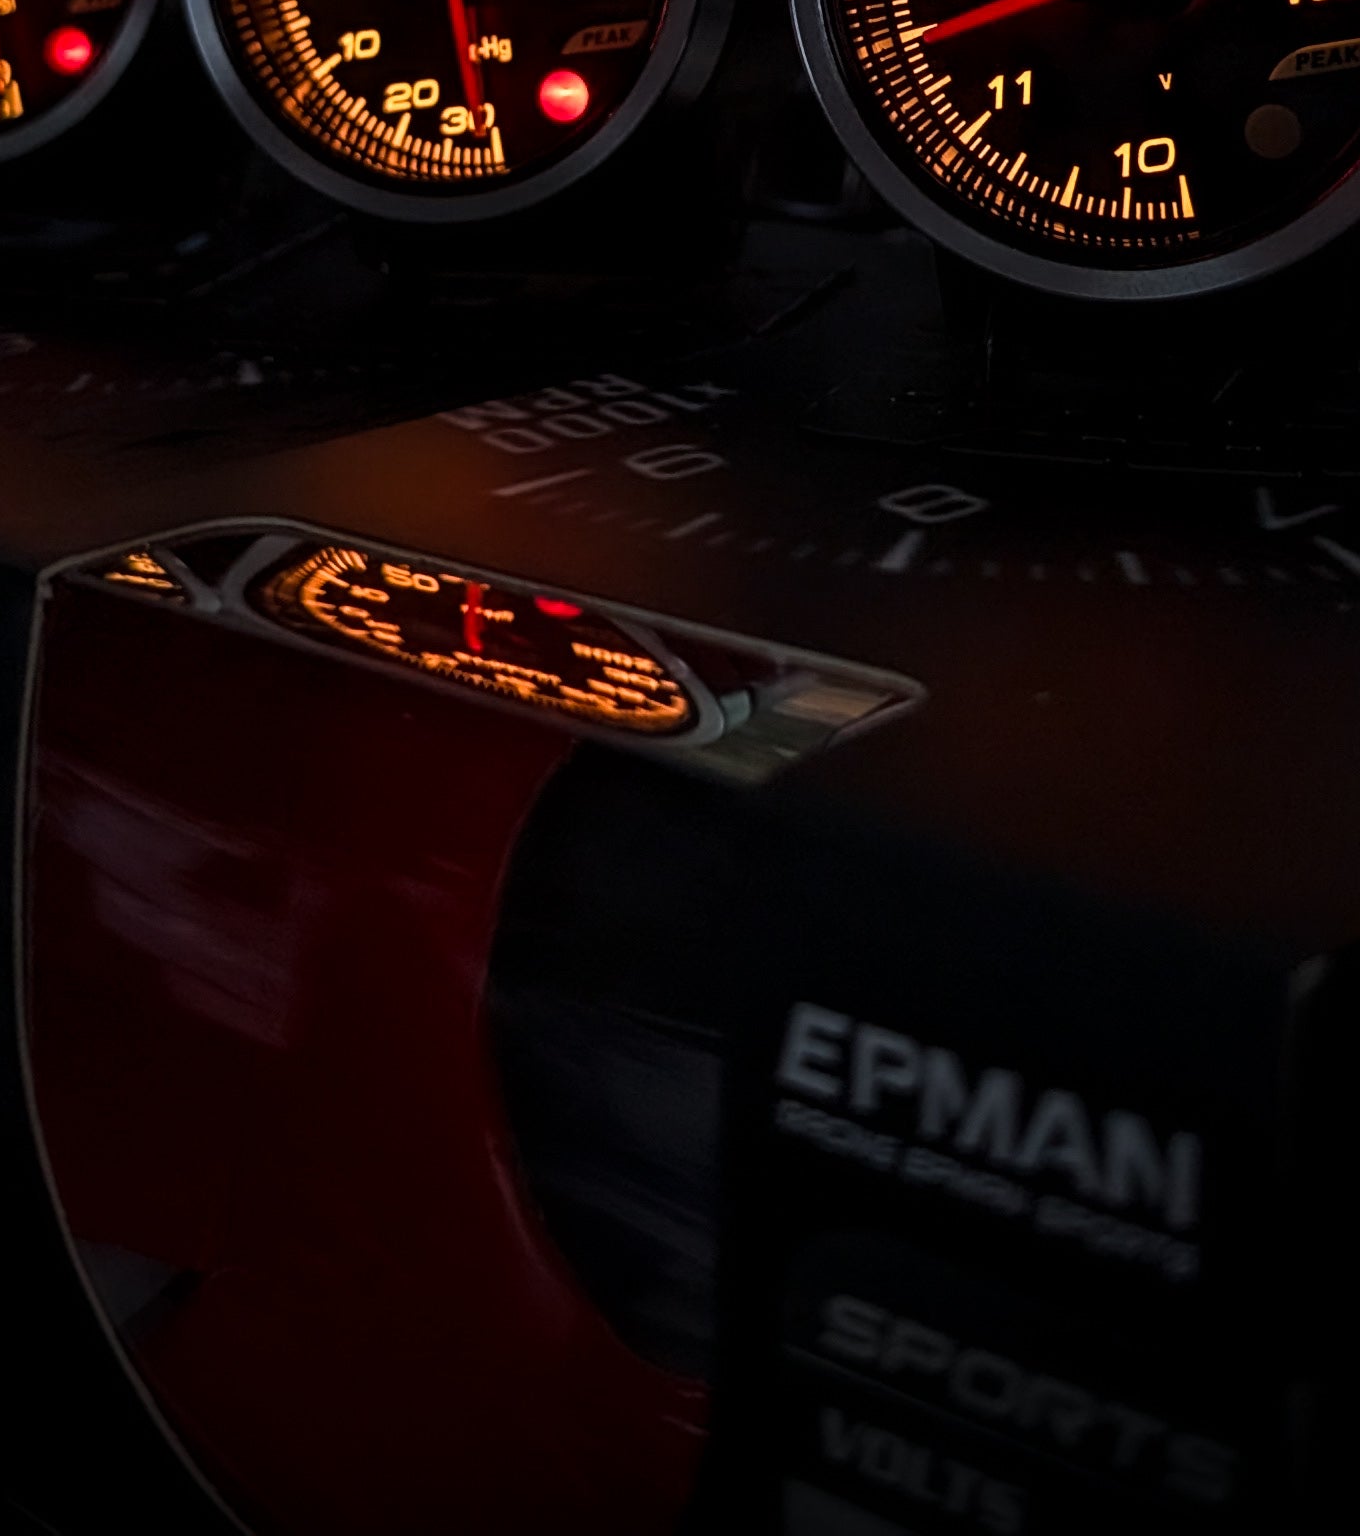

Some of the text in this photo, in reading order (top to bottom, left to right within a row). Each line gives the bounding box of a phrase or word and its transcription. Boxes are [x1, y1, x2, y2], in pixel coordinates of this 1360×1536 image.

[340, 29, 381, 61] 10
[1295, 44, 1360, 71] PEAK
[383, 79, 440, 113] 20
[988, 70, 1032, 109] 11
[1114, 137, 1176, 177] 10
[774, 999, 1207, 1231] EPMAN
[815, 1292, 1239, 1504] SPORTS
